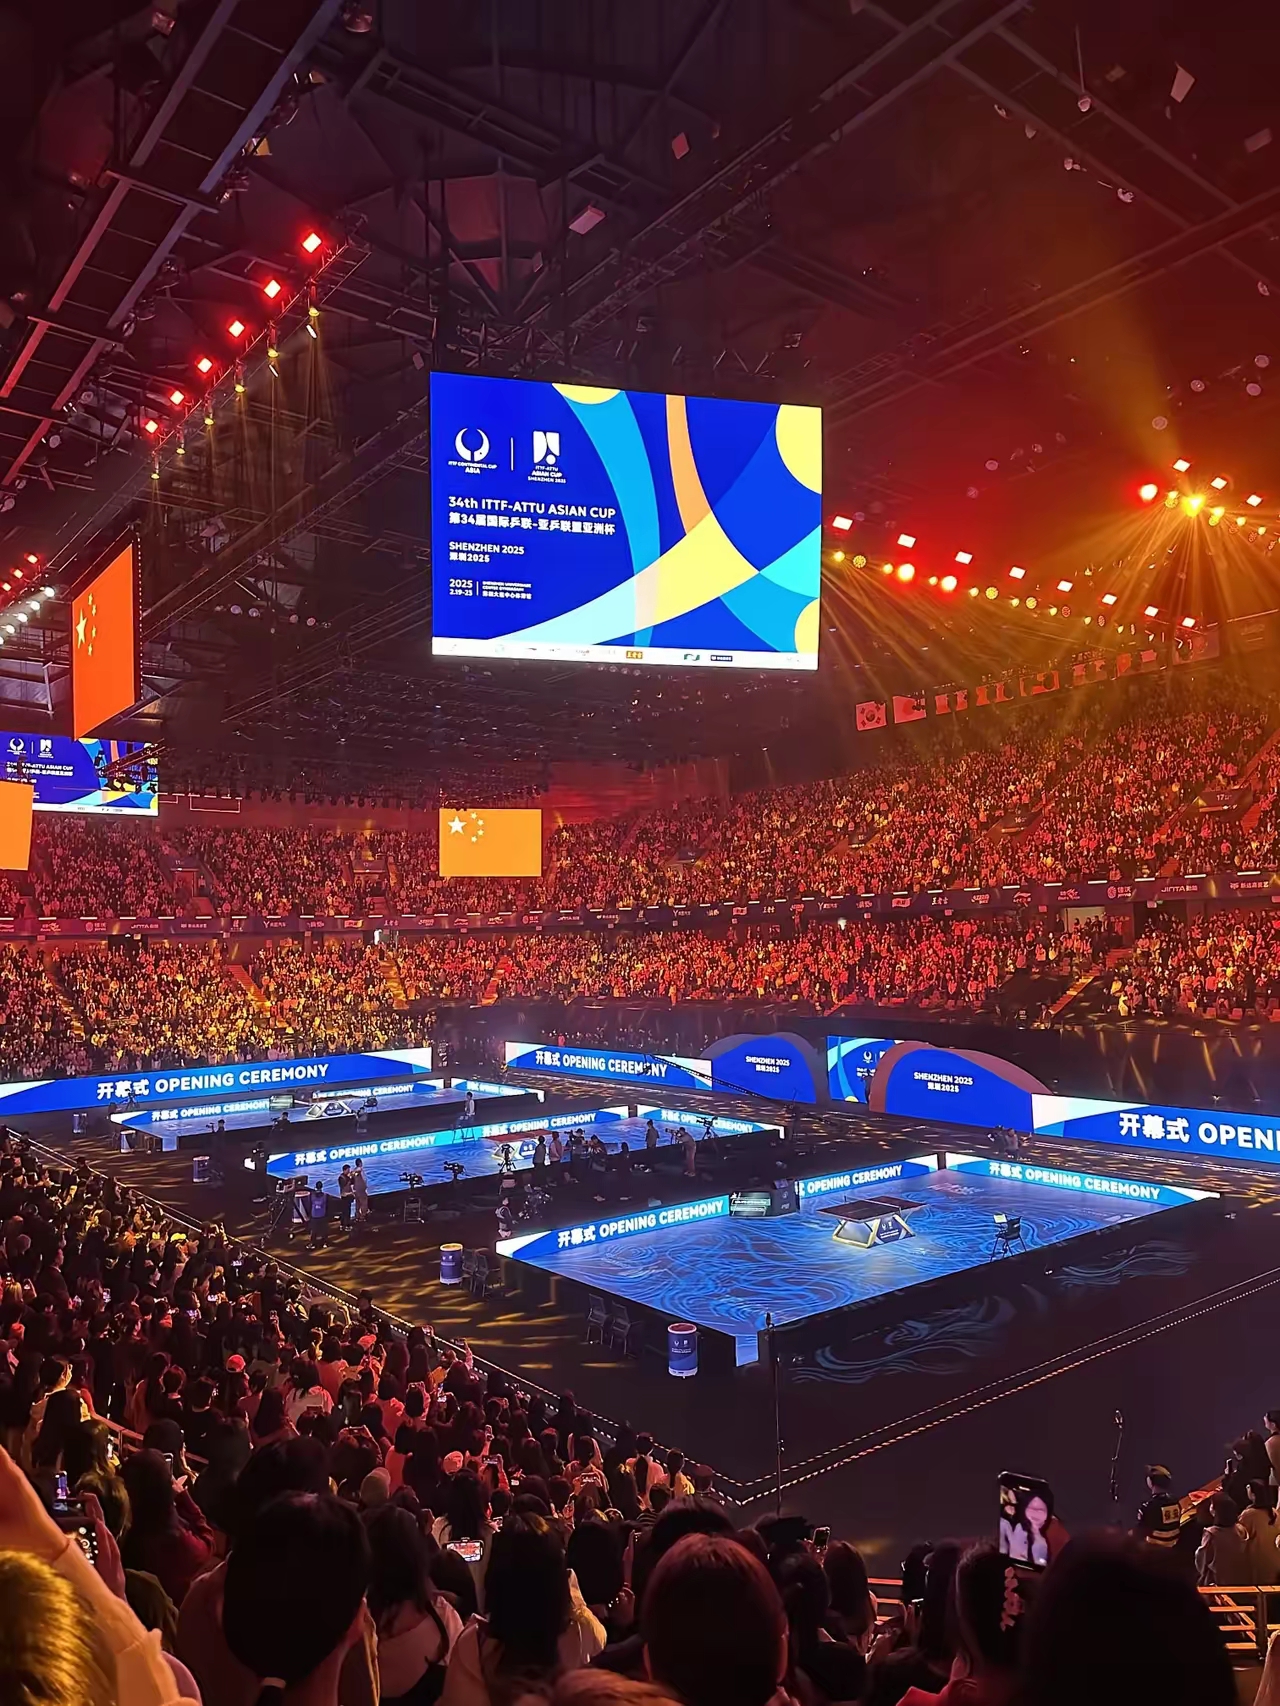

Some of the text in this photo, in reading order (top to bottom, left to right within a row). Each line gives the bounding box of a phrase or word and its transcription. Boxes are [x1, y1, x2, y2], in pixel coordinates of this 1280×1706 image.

[448, 496, 616, 519] 34th ITTF-ATTU ASIAN CUP
[449, 541, 525, 555] SHENZHEN 2025
[449, 578, 473, 589] 2025
[535, 1050, 561, 1068] 开幕式
[562, 1054, 606, 1072] OPENING
[745, 1055, 790, 1067] SHENZHEN 2025
[97, 1063, 330, 1100] 开幕式 OPENING CEREMONY
[913, 1071, 974, 1086] SHENZHEN 2025
[372, 1084, 414, 1097] CEREMONY
[180, 1105, 221, 1118] OPENING
[510, 1119, 549, 1133] OPENING
[551, 1112, 596, 1127] CEREMONY
[1119, 1112, 1190, 1143] 开幕式
[295, 1136, 436, 1166] 开幕式 OPENING CEREMONY
[807, 1165, 903, 1194] OPENING CEREMONY
[989, 1162, 1161, 1200] 开幕式 OPENING CEREMONY
[557, 1200, 724, 1248] 开幕式 OPENING CEREMONY
